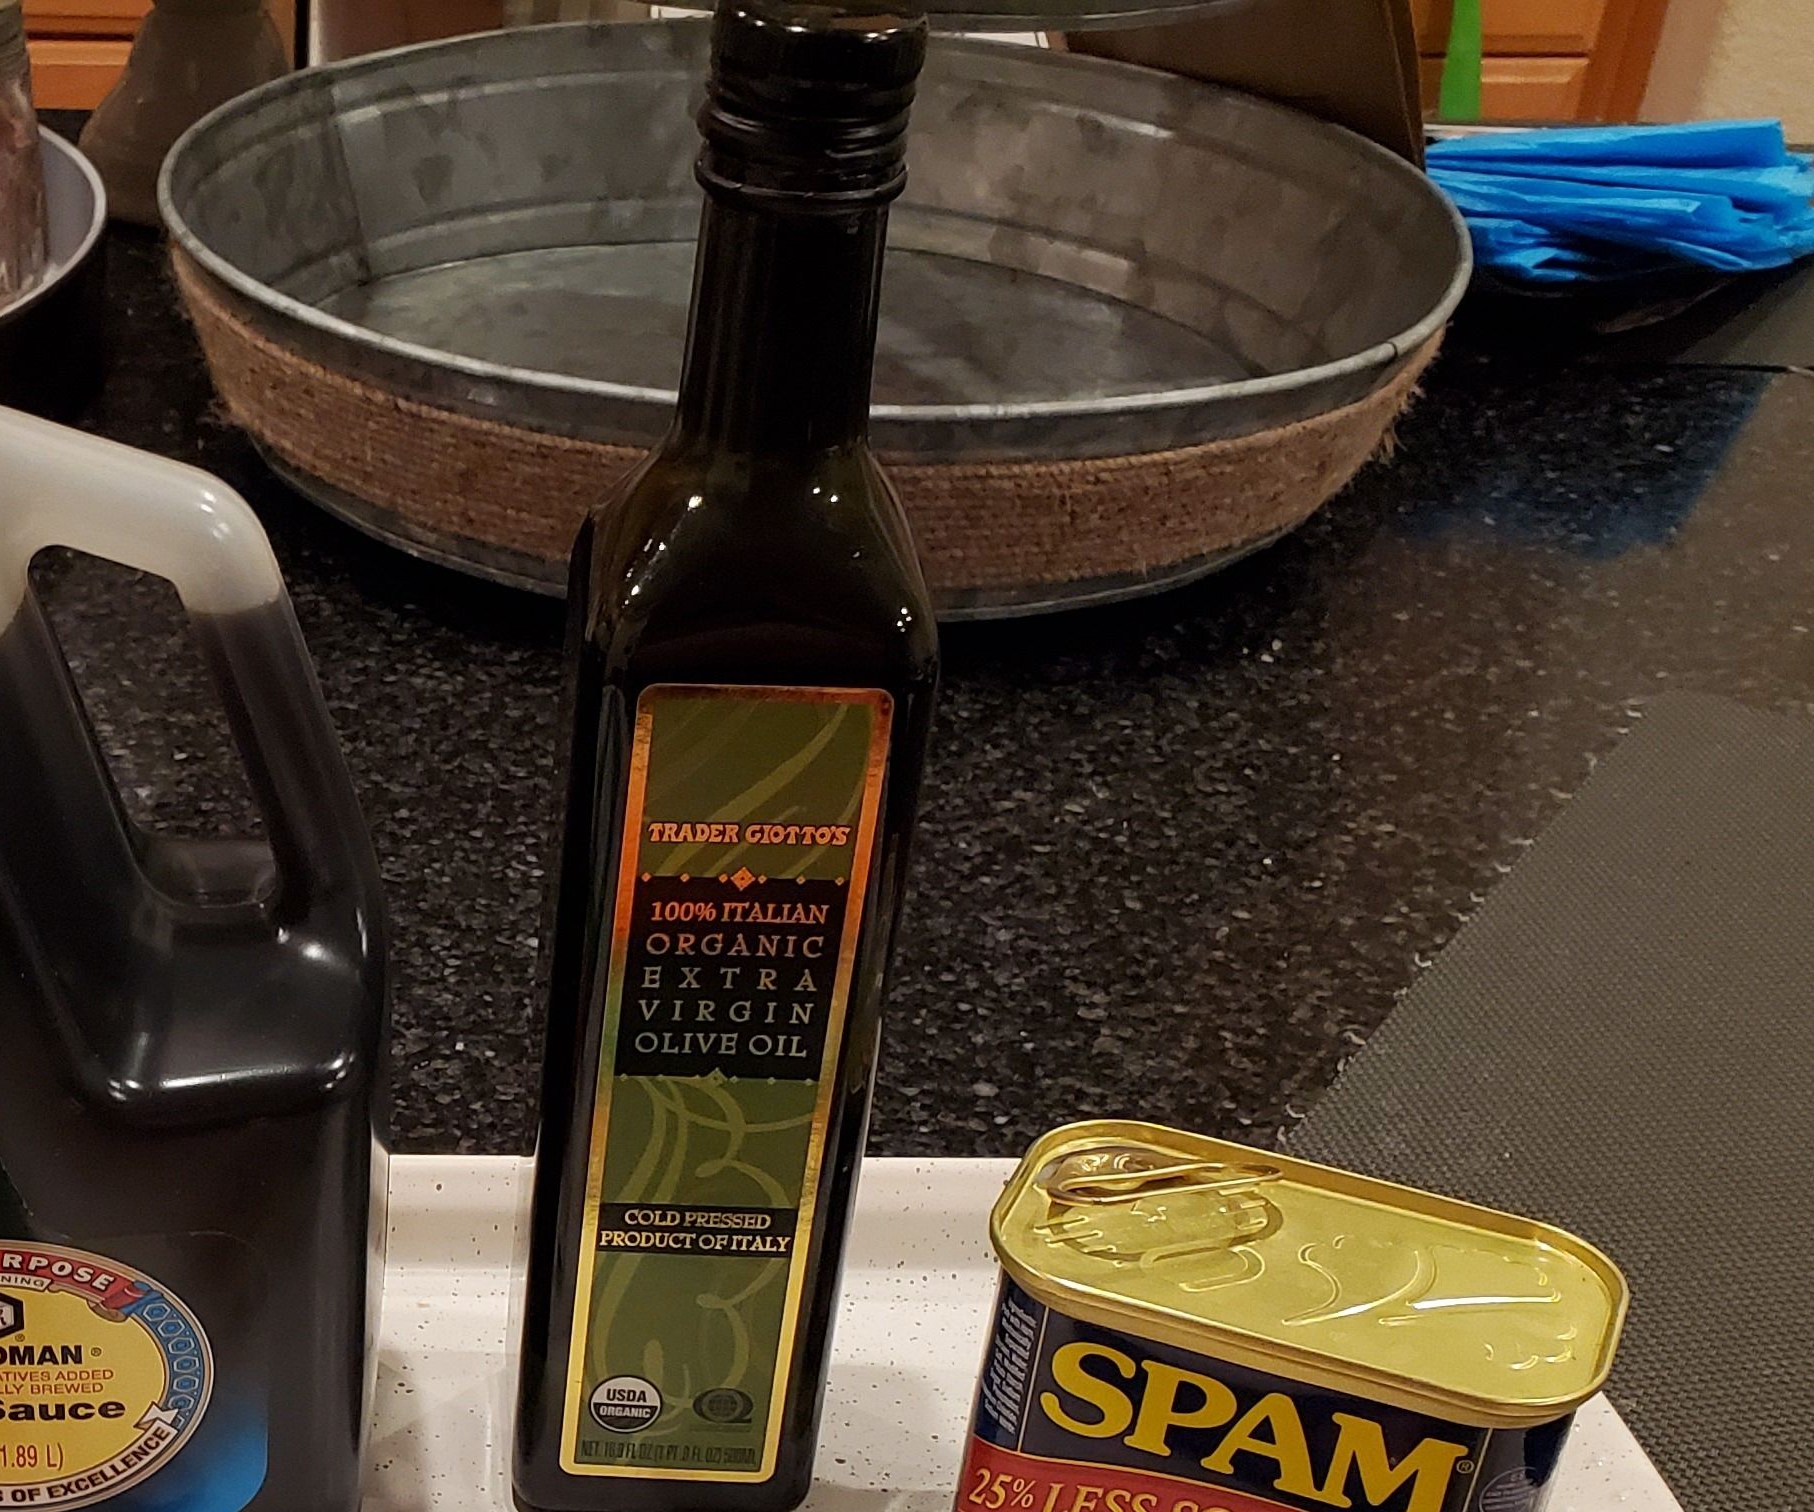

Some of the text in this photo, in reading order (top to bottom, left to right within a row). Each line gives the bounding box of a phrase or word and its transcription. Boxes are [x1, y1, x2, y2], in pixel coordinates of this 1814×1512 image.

[648, 822, 851, 846] TRADER GIOTTO'S
[651, 901, 830, 925] 100% ITALIAN
[646, 933, 825, 959] ORGANIC
[641, 966, 818, 992] EXTRA
[638, 1000, 815, 1025] VIRGIN
[635, 1031, 807, 1058] OLIVE OIL
[624, 1209, 772, 1230] COLD PRESSED
[599, 1230, 791, 1252] PRODUCT OF ITALY
[54, 1368, 114, 1382] ADDED
[30, 1381, 104, 1395] BREWED
[606, 1388, 647, 1403] USDA
[599, 1405, 652, 1419] ORGANIC
[10, 1487, 42, 1503] OF
[47, 1427, 172, 1500] EXCELLENCE
[45, 1442, 65, 1471] L)
[968, 1467, 1036, 1509] 25%
